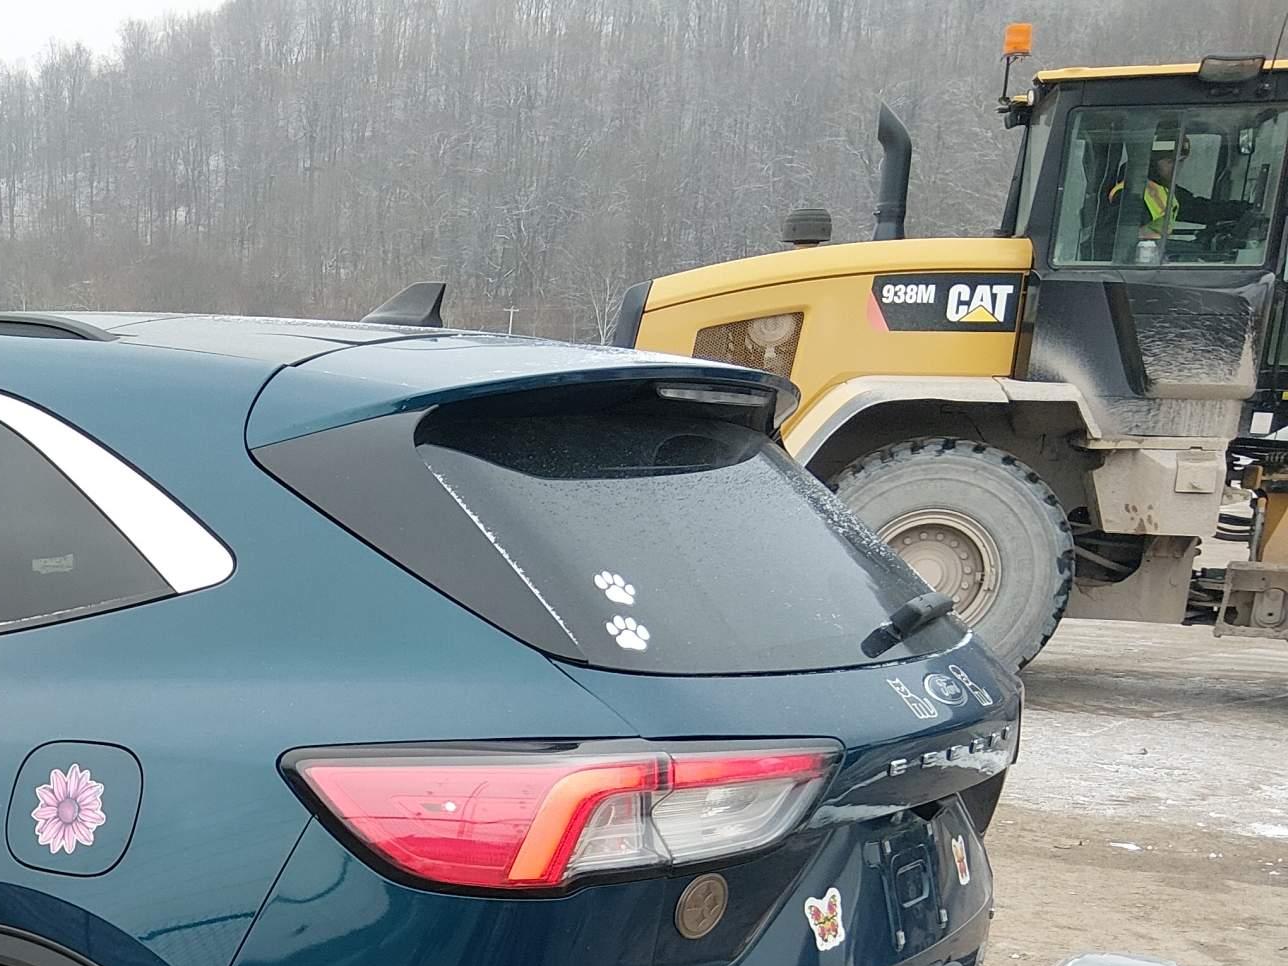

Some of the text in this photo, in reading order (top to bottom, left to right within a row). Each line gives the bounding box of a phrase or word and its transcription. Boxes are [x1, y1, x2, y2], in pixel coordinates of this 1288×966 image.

[881, 283, 1014, 322] 938M CAT
[888, 726, 1010, 776] ESCAP
